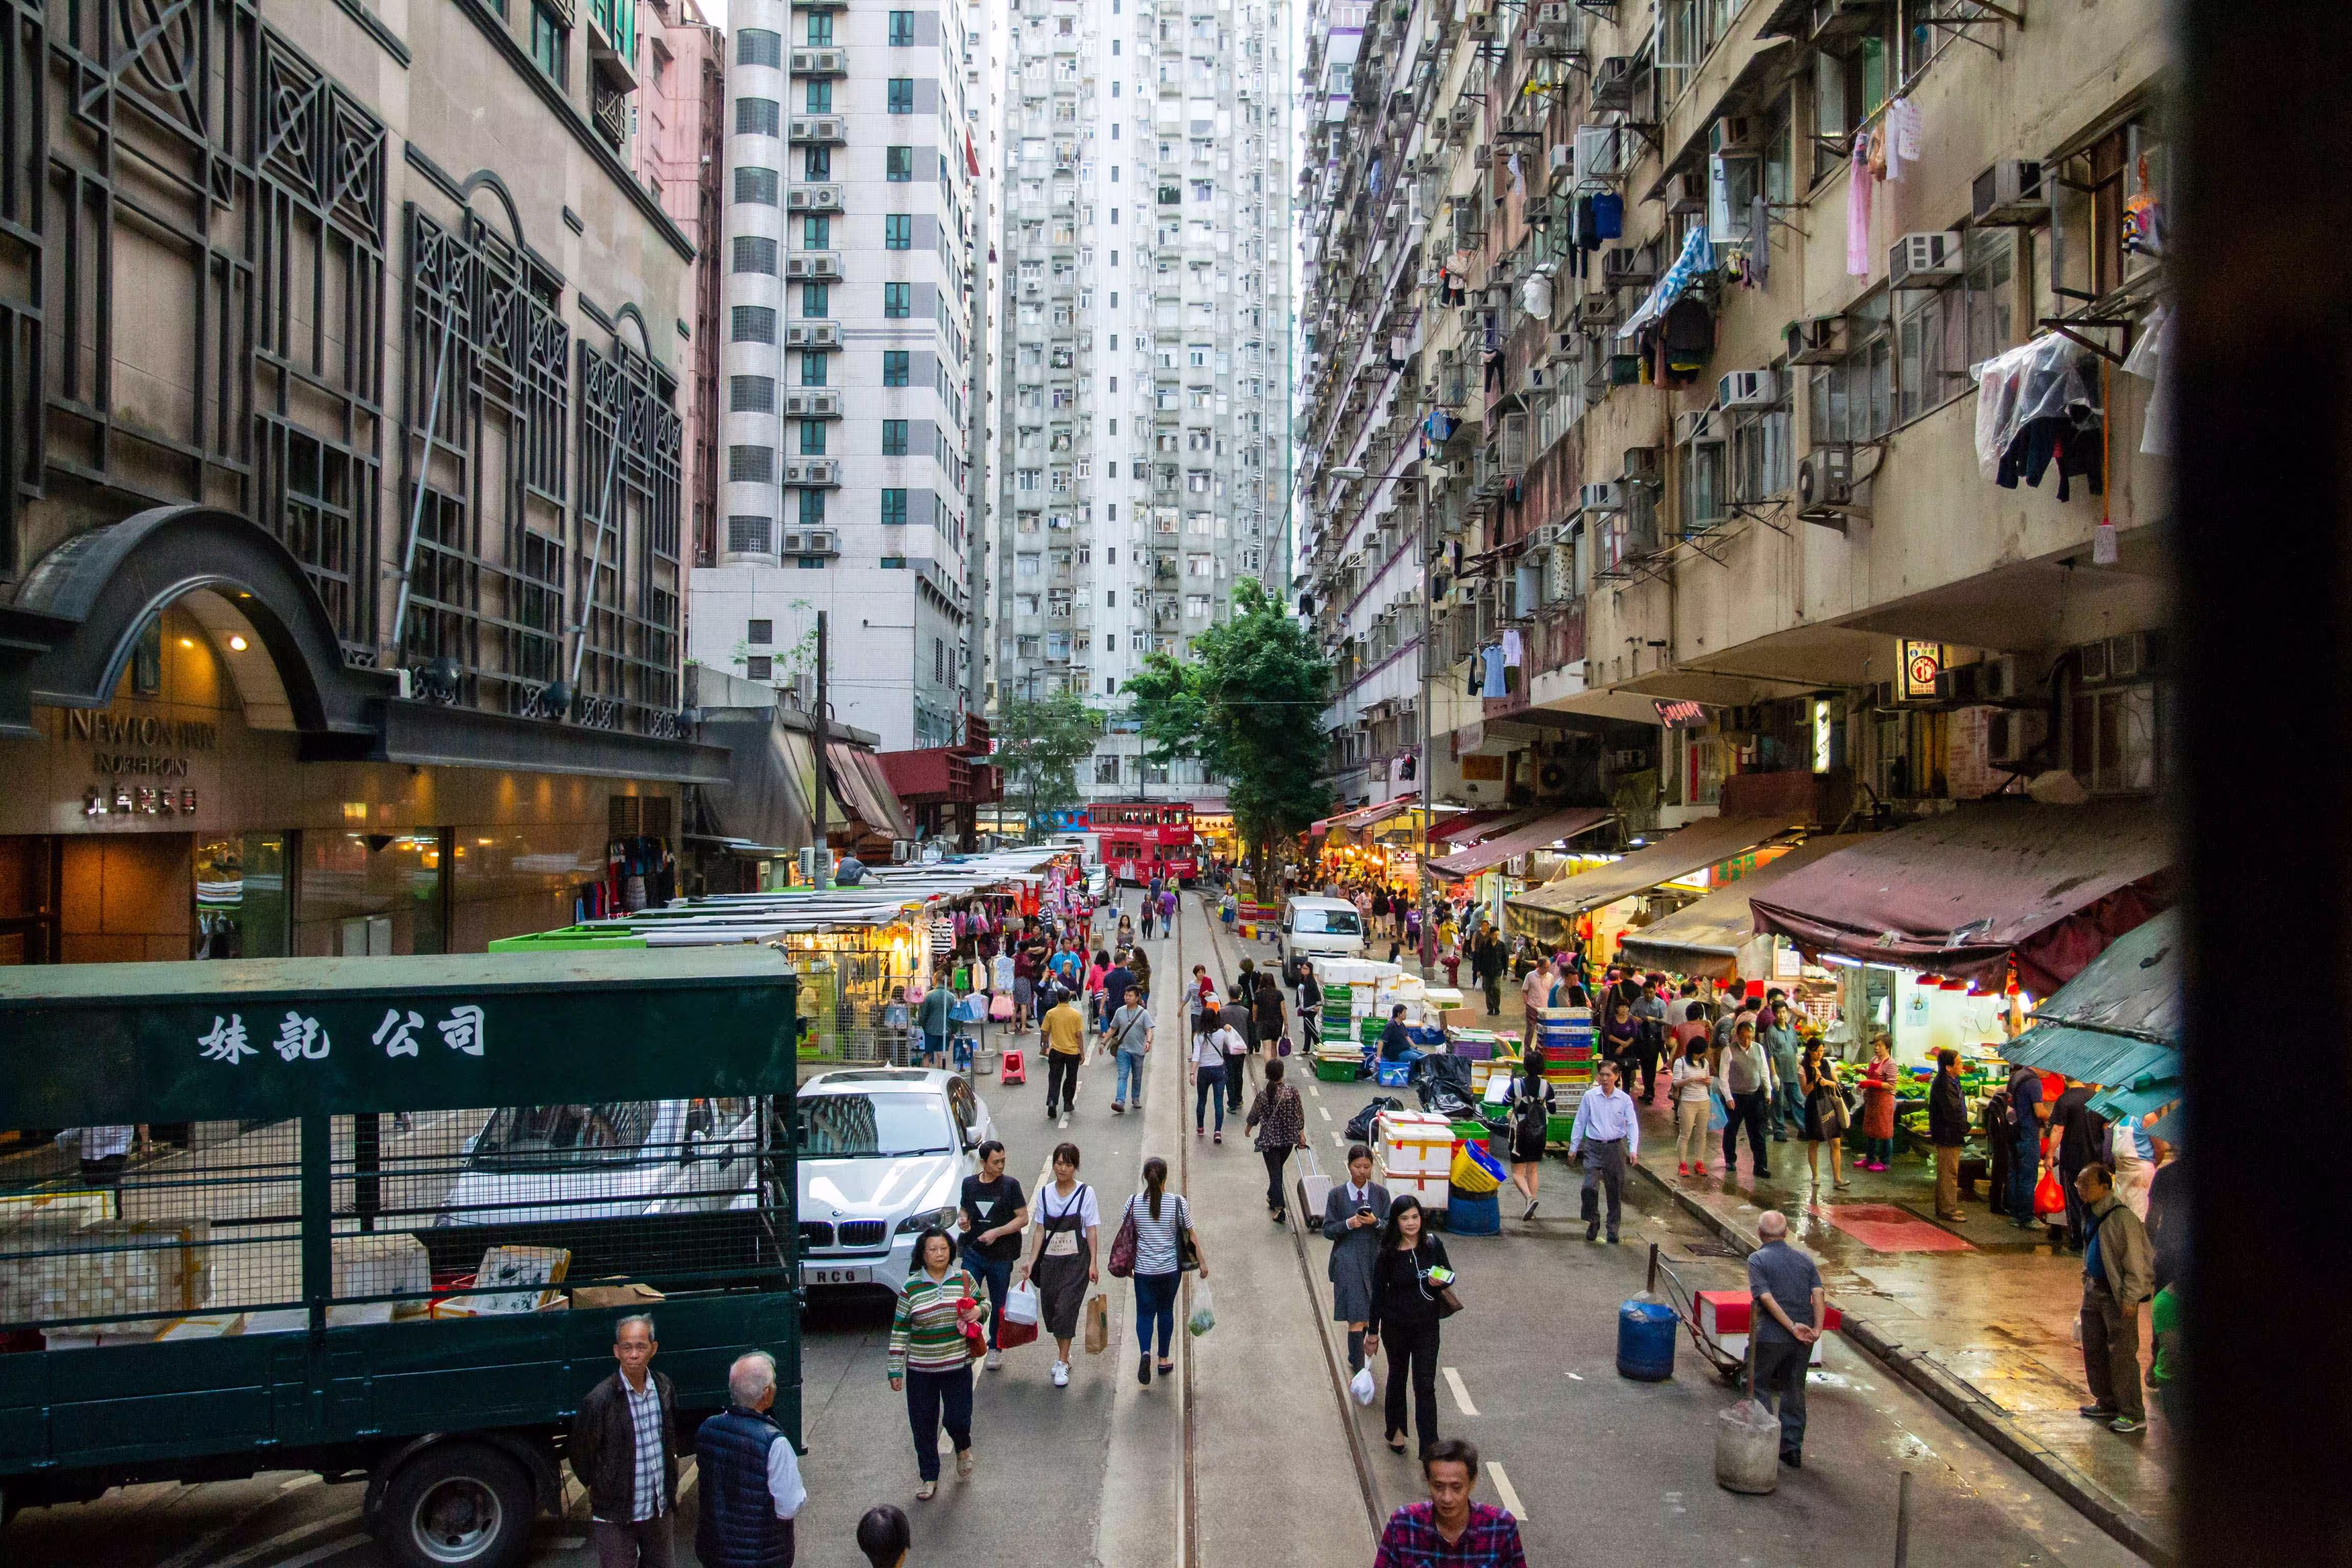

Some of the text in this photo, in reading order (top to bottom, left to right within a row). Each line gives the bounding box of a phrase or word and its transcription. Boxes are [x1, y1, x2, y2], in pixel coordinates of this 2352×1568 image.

[69, 709, 175, 745] NEWTON
[100, 754, 195, 778] NORTH POINT
[197, 1004, 484, 1065] 妹記 公司
[817, 1270, 855, 1283] RCG
